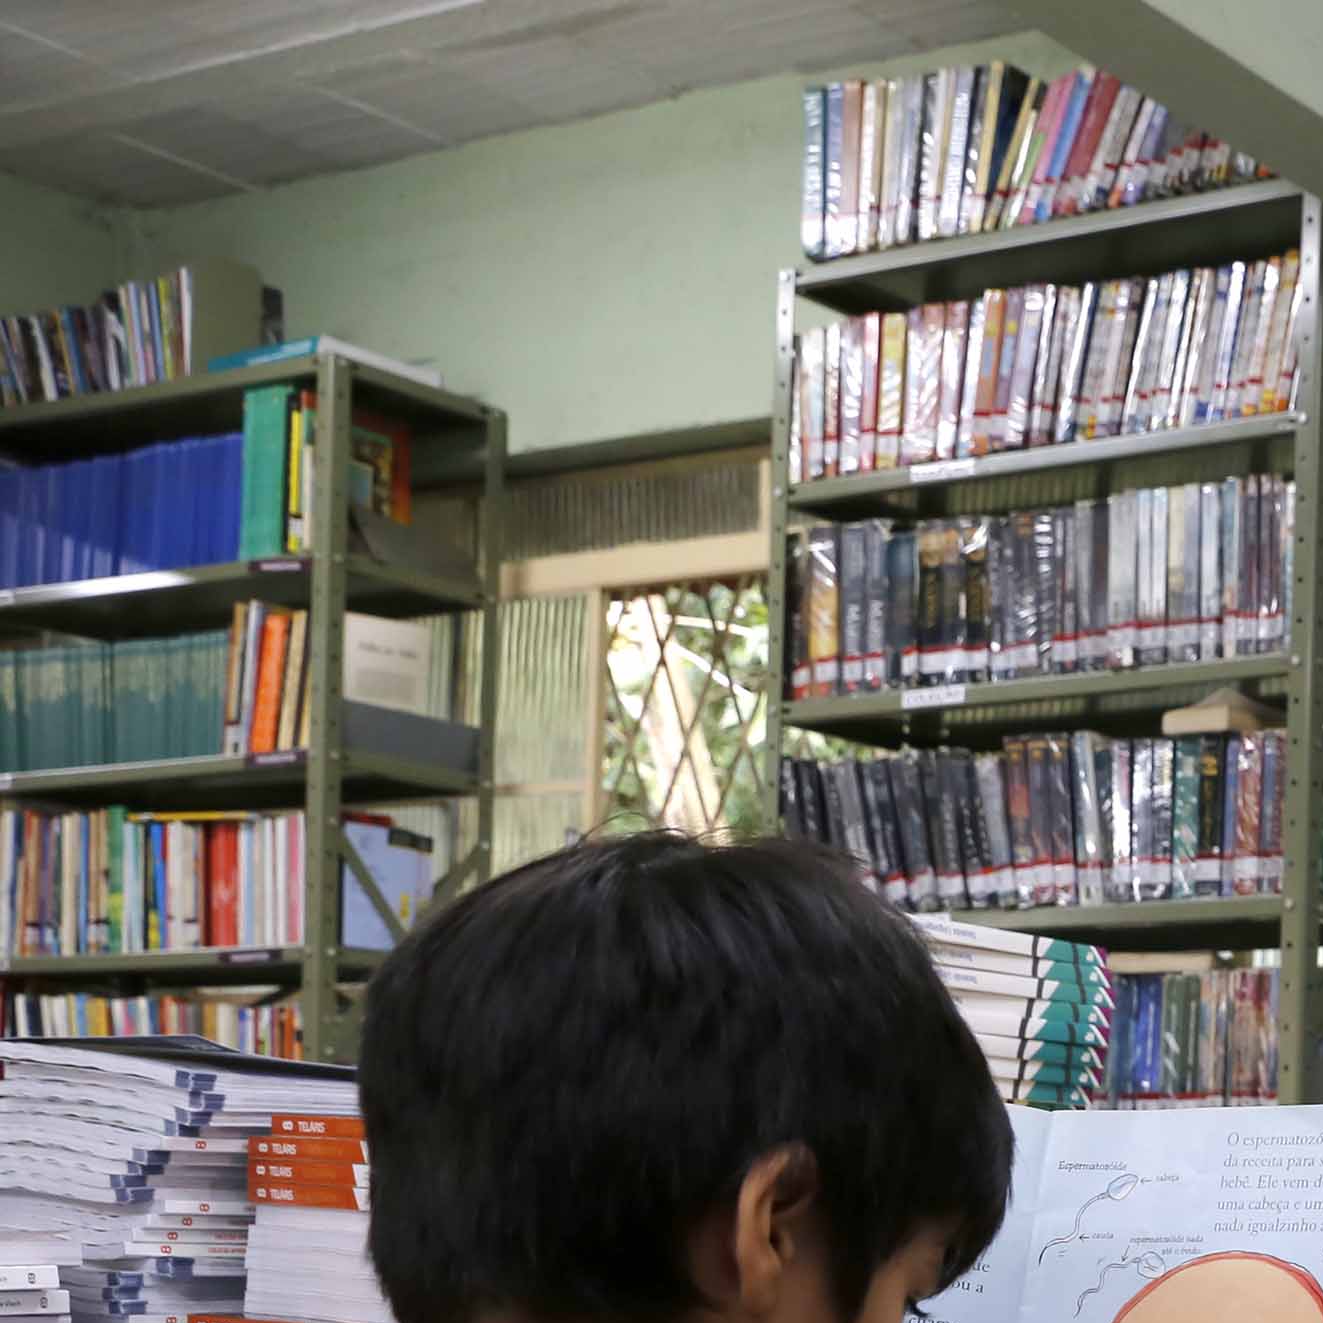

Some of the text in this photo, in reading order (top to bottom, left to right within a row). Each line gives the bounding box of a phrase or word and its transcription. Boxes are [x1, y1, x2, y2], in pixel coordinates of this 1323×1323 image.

[1227, 1132, 1240, 1146] O
[1223, 1154, 1239, 1168] da
[1242, 1155, 1283, 1168] receita
[1286, 1156, 1315, 1171] para
[1256, 1175, 1279, 1190] Ele
[1282, 1178, 1309, 1190] vem
[1217, 1199, 1245, 1211] uma
[1248, 1196, 1290, 1213] cabeça
[1293, 1201, 1302, 1211] e
[1214, 1219, 1245, 1233] nada
[1247, 1218, 1317, 1236] igualzinho
[975, 1283, 985, 1294] a
